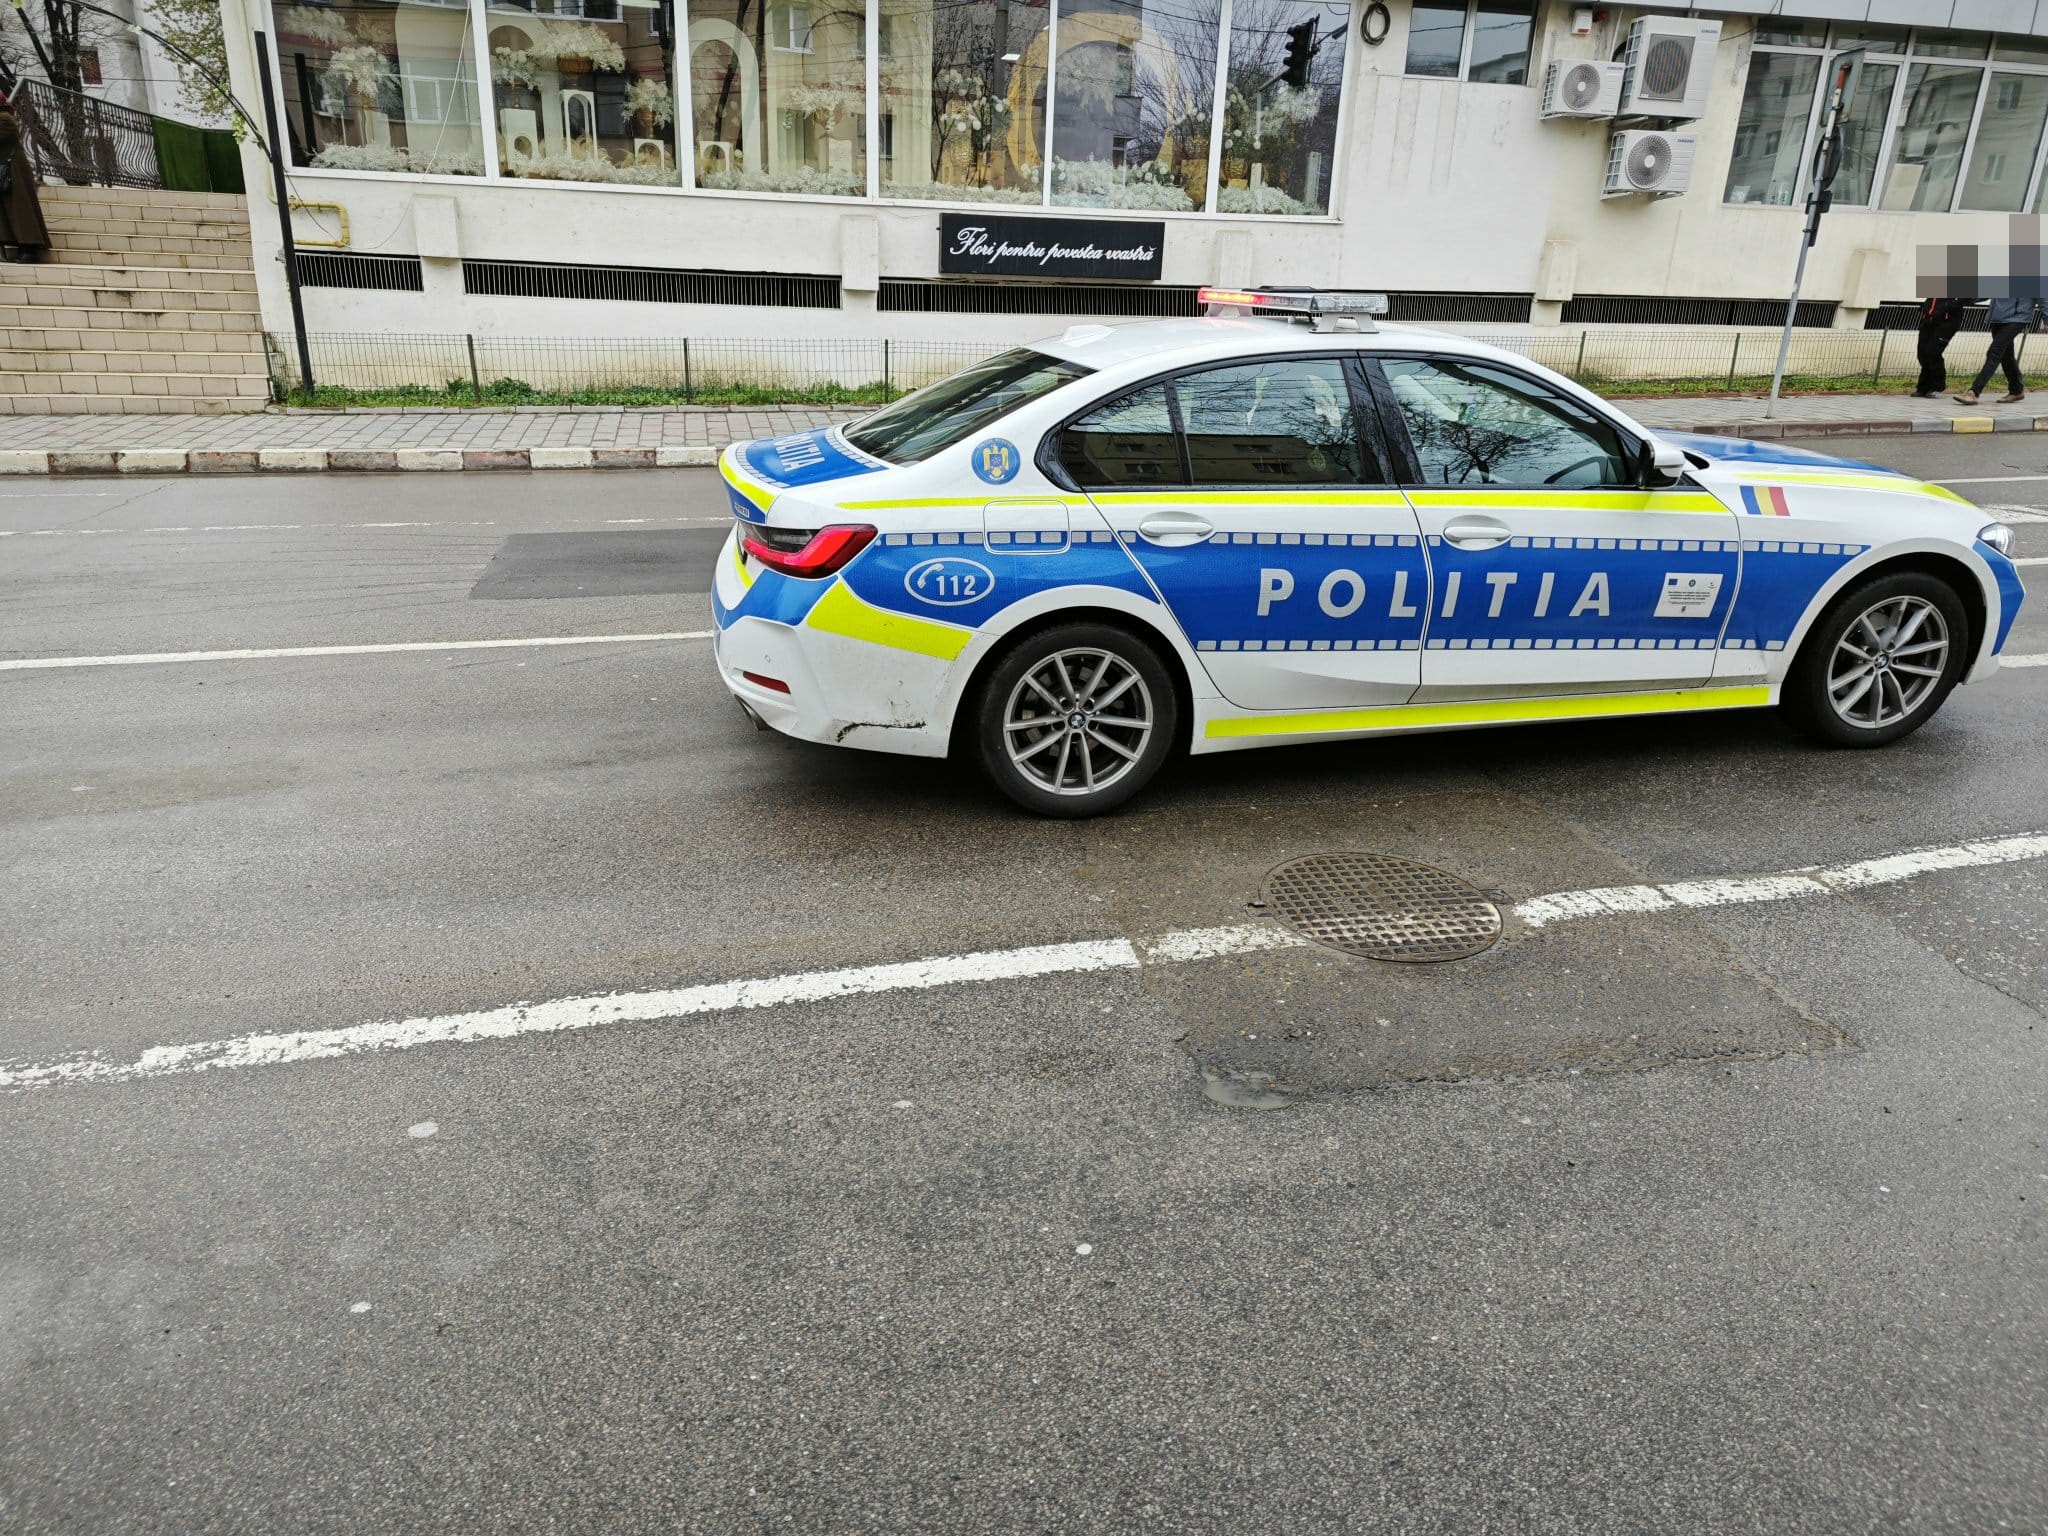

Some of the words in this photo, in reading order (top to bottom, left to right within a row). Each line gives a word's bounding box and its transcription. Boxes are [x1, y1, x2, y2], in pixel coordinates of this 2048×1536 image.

[950, 226, 995, 256] Flori
[986, 241, 1046, 265] pentru
[1039, 243, 1104, 266] povestea
[1103, 245, 1157, 262] voastră
[935, 575, 977, 597] 112
[1256, 567, 1611, 618] POLITIA
